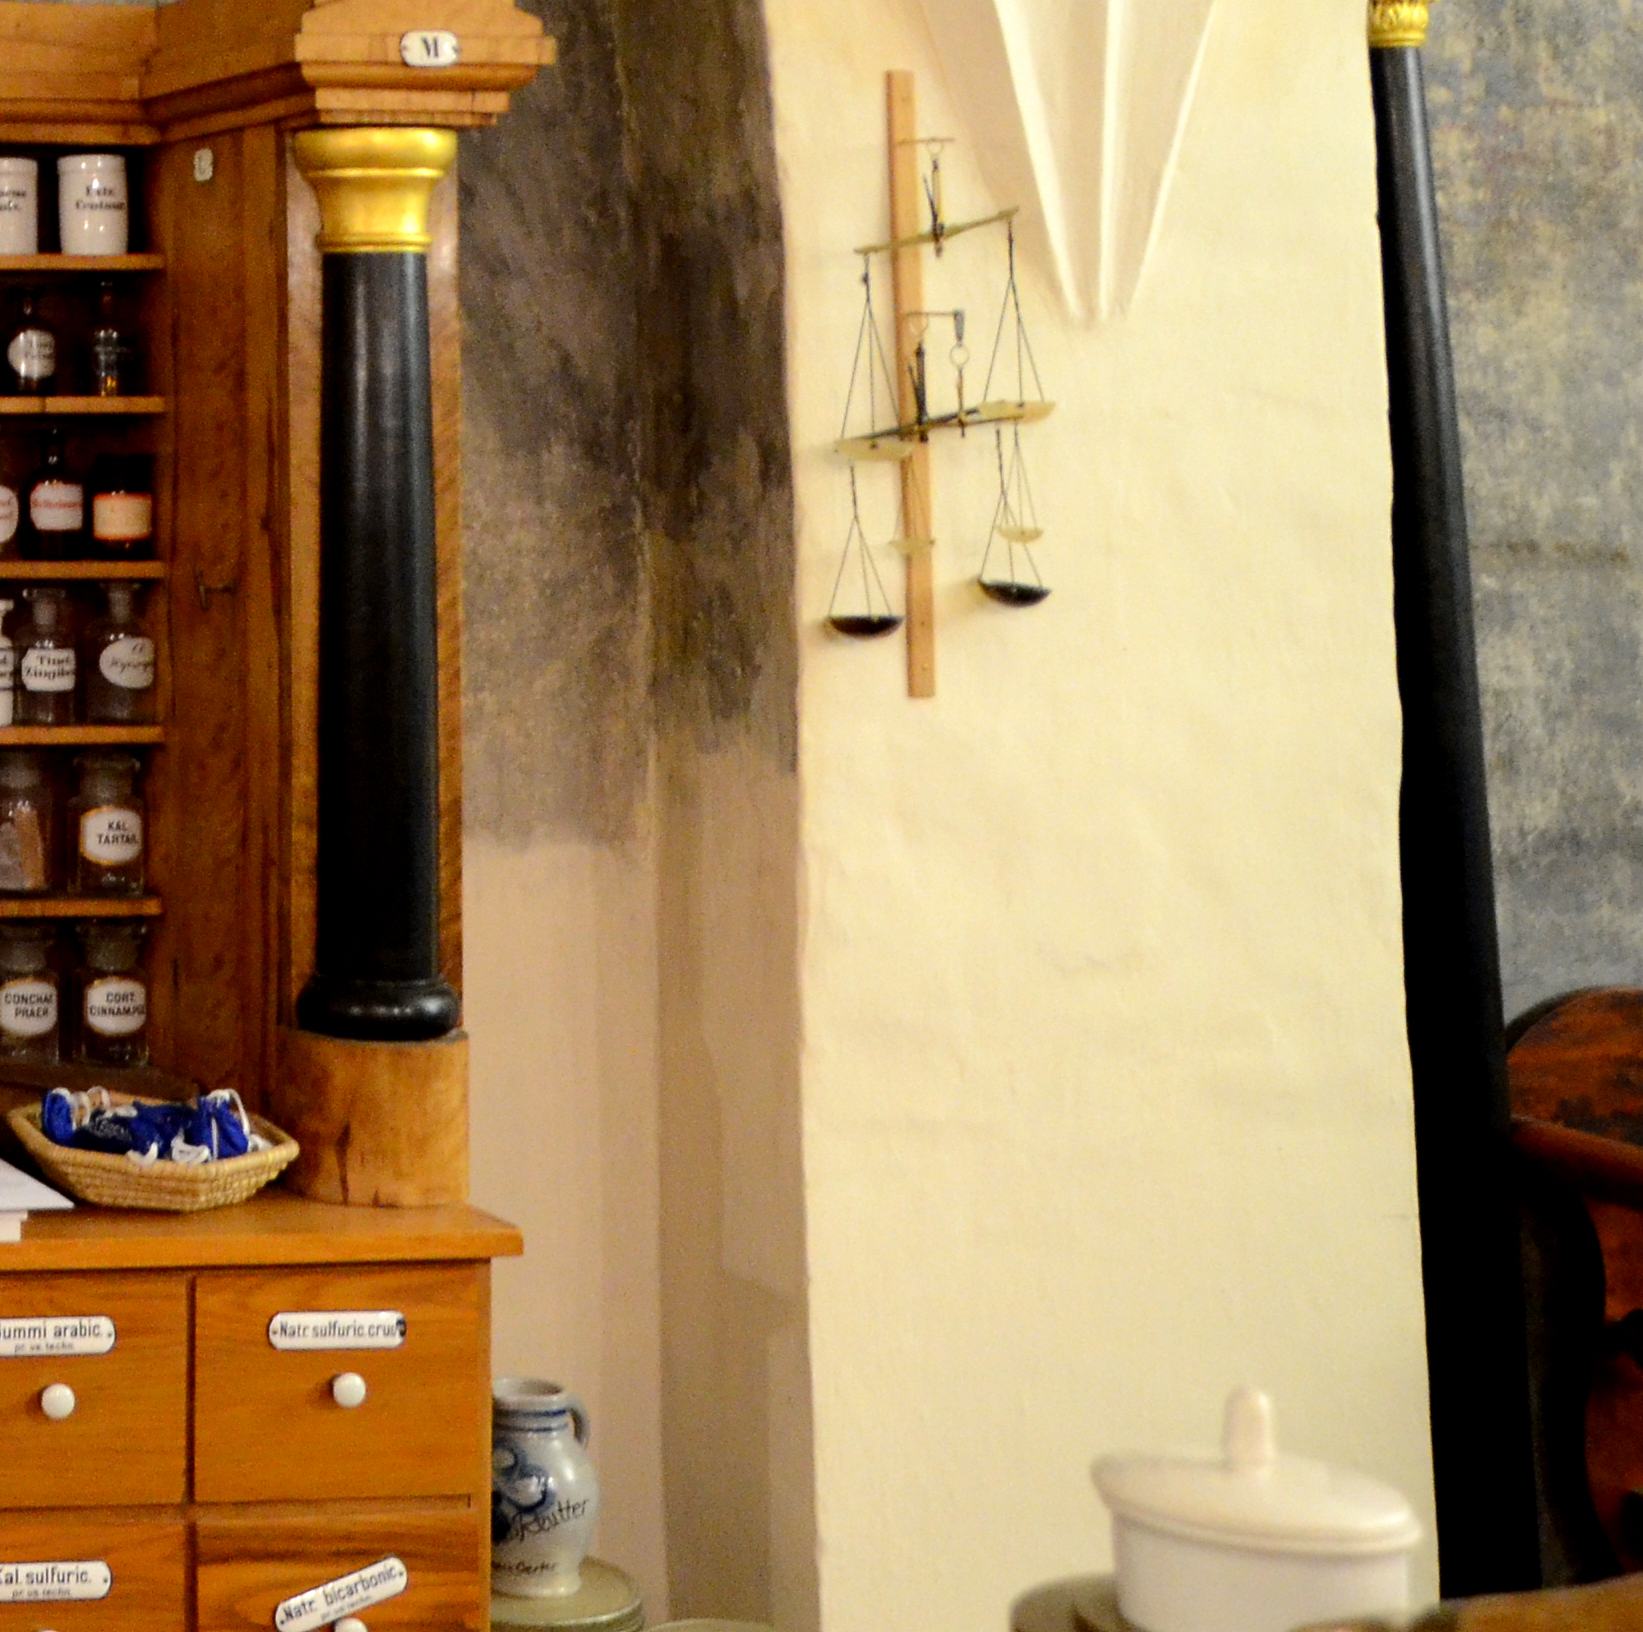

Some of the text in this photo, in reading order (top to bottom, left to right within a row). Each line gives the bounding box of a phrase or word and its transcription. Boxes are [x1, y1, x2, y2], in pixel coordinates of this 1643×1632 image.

[52, 1317, 105, 1339] arabic.
[24, 1563, 93, 1585] sulfuric.
[280, 1596, 318, 1623] Natr.
[323, 1564, 399, 1606] bicarbonic.
